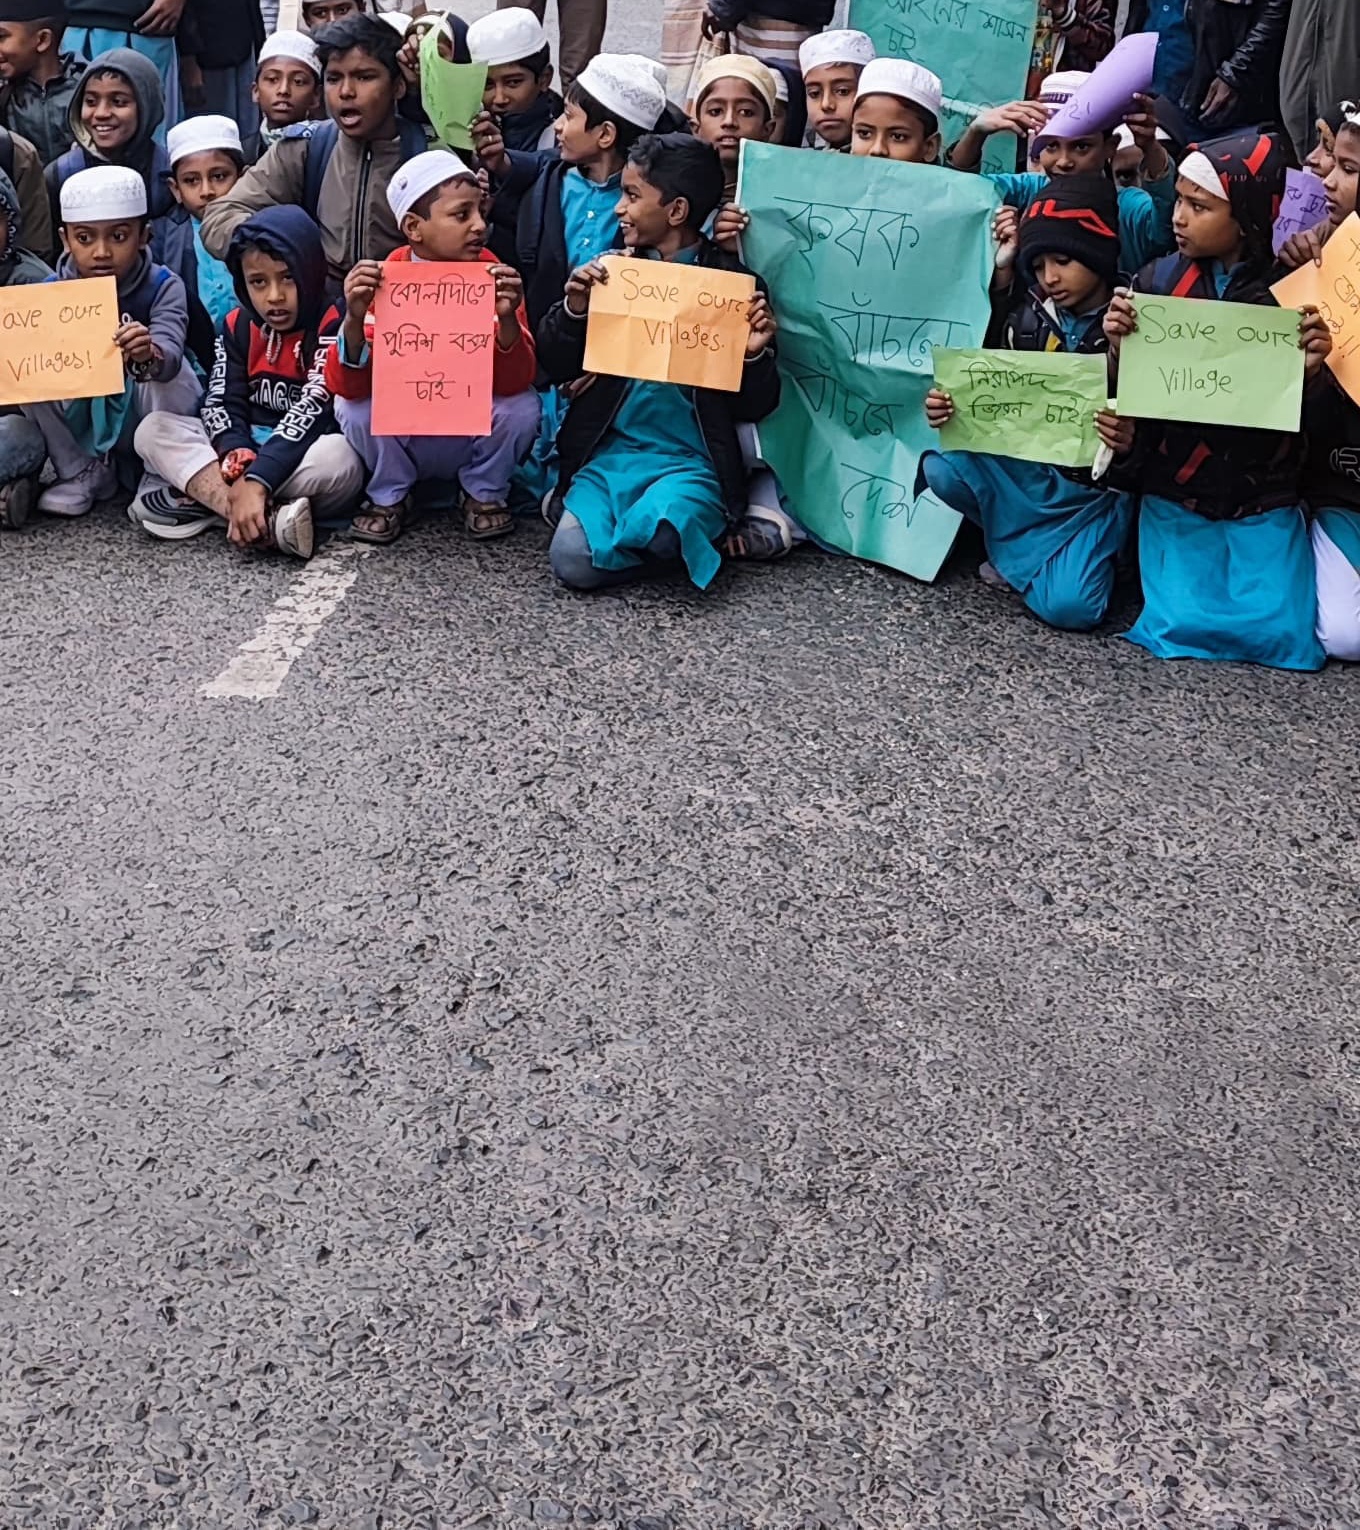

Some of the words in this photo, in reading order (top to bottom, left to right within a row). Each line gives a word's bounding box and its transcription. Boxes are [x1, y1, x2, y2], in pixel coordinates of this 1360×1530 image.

[774, 196, 920, 281] কৃষক
[620, 268, 680, 302] Save
[1139, 304, 1217, 345] Save
[7, 350, 93, 382] Villages!
[1158, 366, 1234, 399] Village
